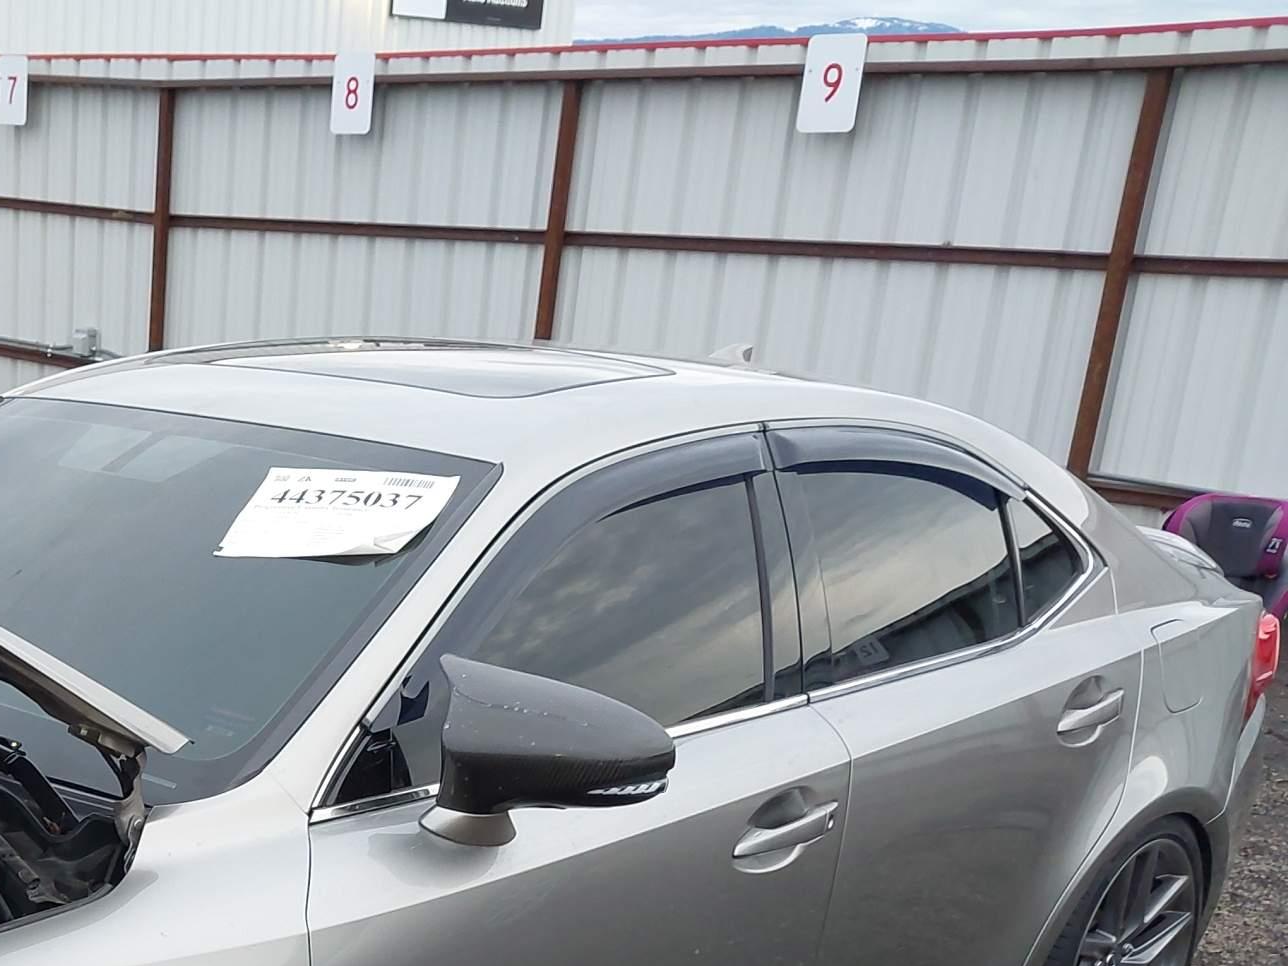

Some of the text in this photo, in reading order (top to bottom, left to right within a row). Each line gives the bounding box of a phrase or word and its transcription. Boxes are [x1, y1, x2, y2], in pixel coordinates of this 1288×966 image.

[7, 76, 17, 104] 7
[344, 76, 359, 109] 8
[822, 62, 843, 103] 9
[271, 488, 424, 511] 44375037
